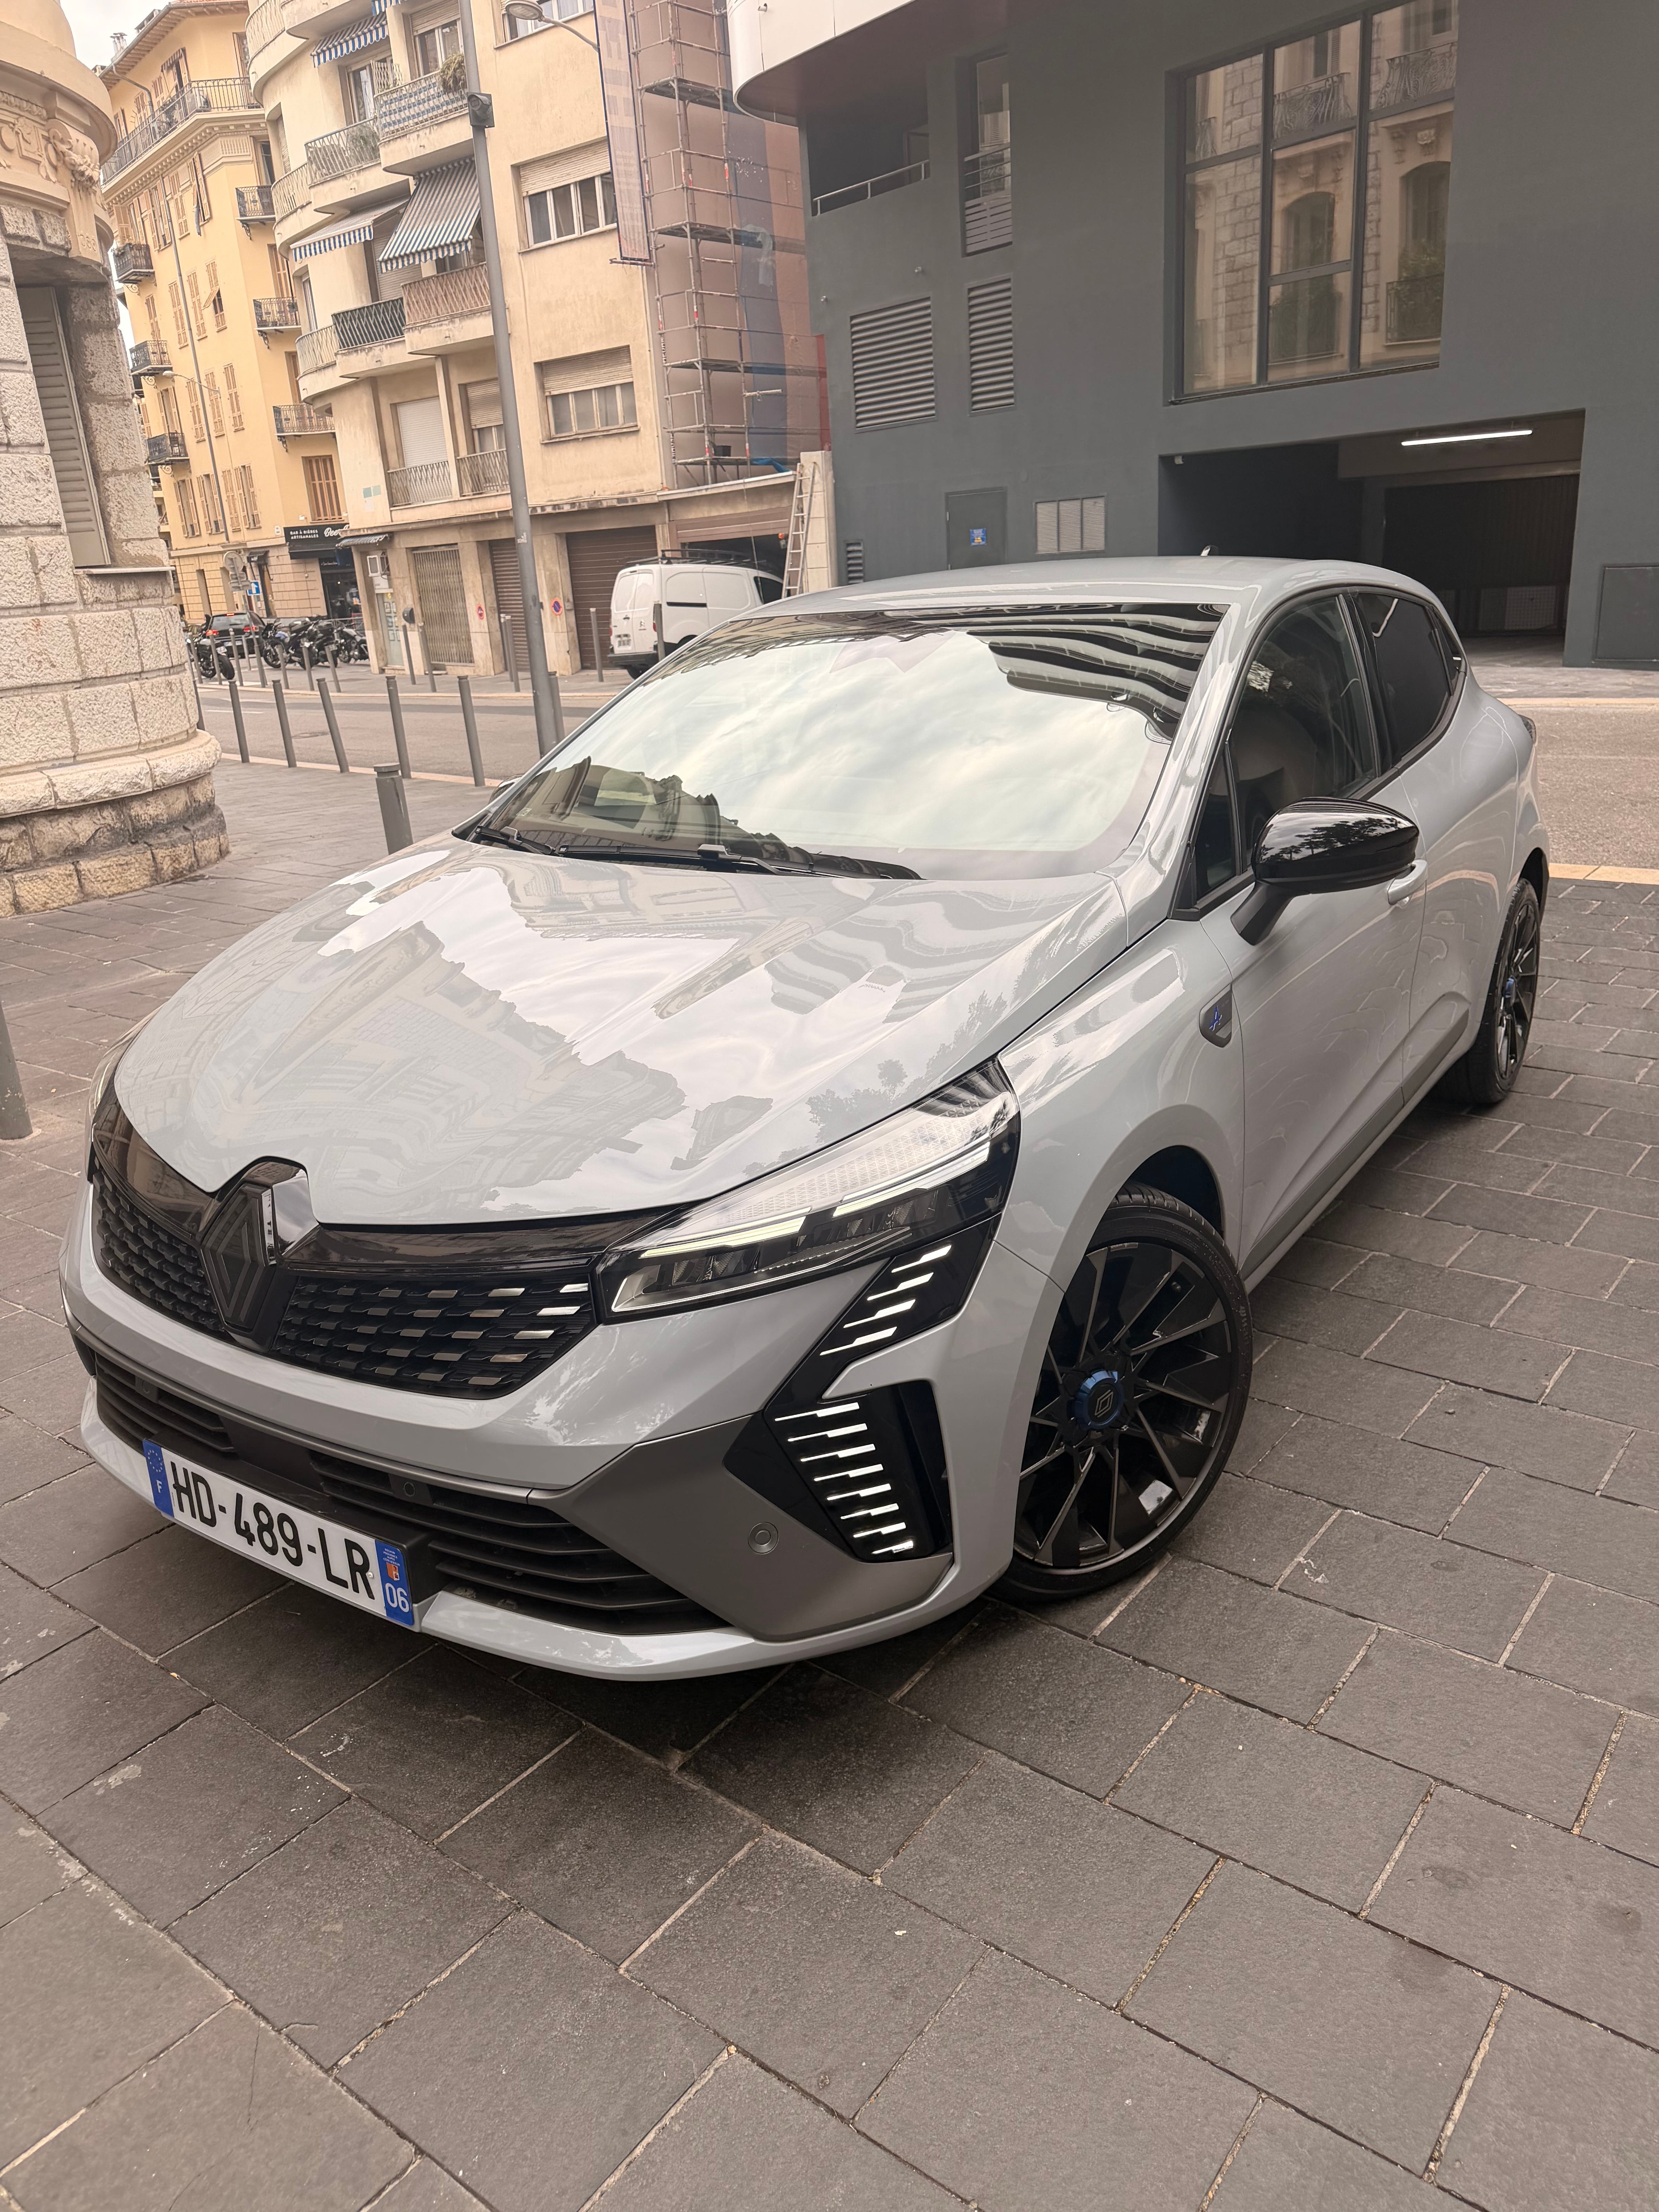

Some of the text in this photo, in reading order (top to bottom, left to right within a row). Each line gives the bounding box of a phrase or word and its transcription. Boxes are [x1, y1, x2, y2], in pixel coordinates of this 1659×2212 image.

[156, 1479, 162, 1493] F
[170, 1461, 375, 1600] HD-489-LR
[385, 1583, 409, 1613] 06
